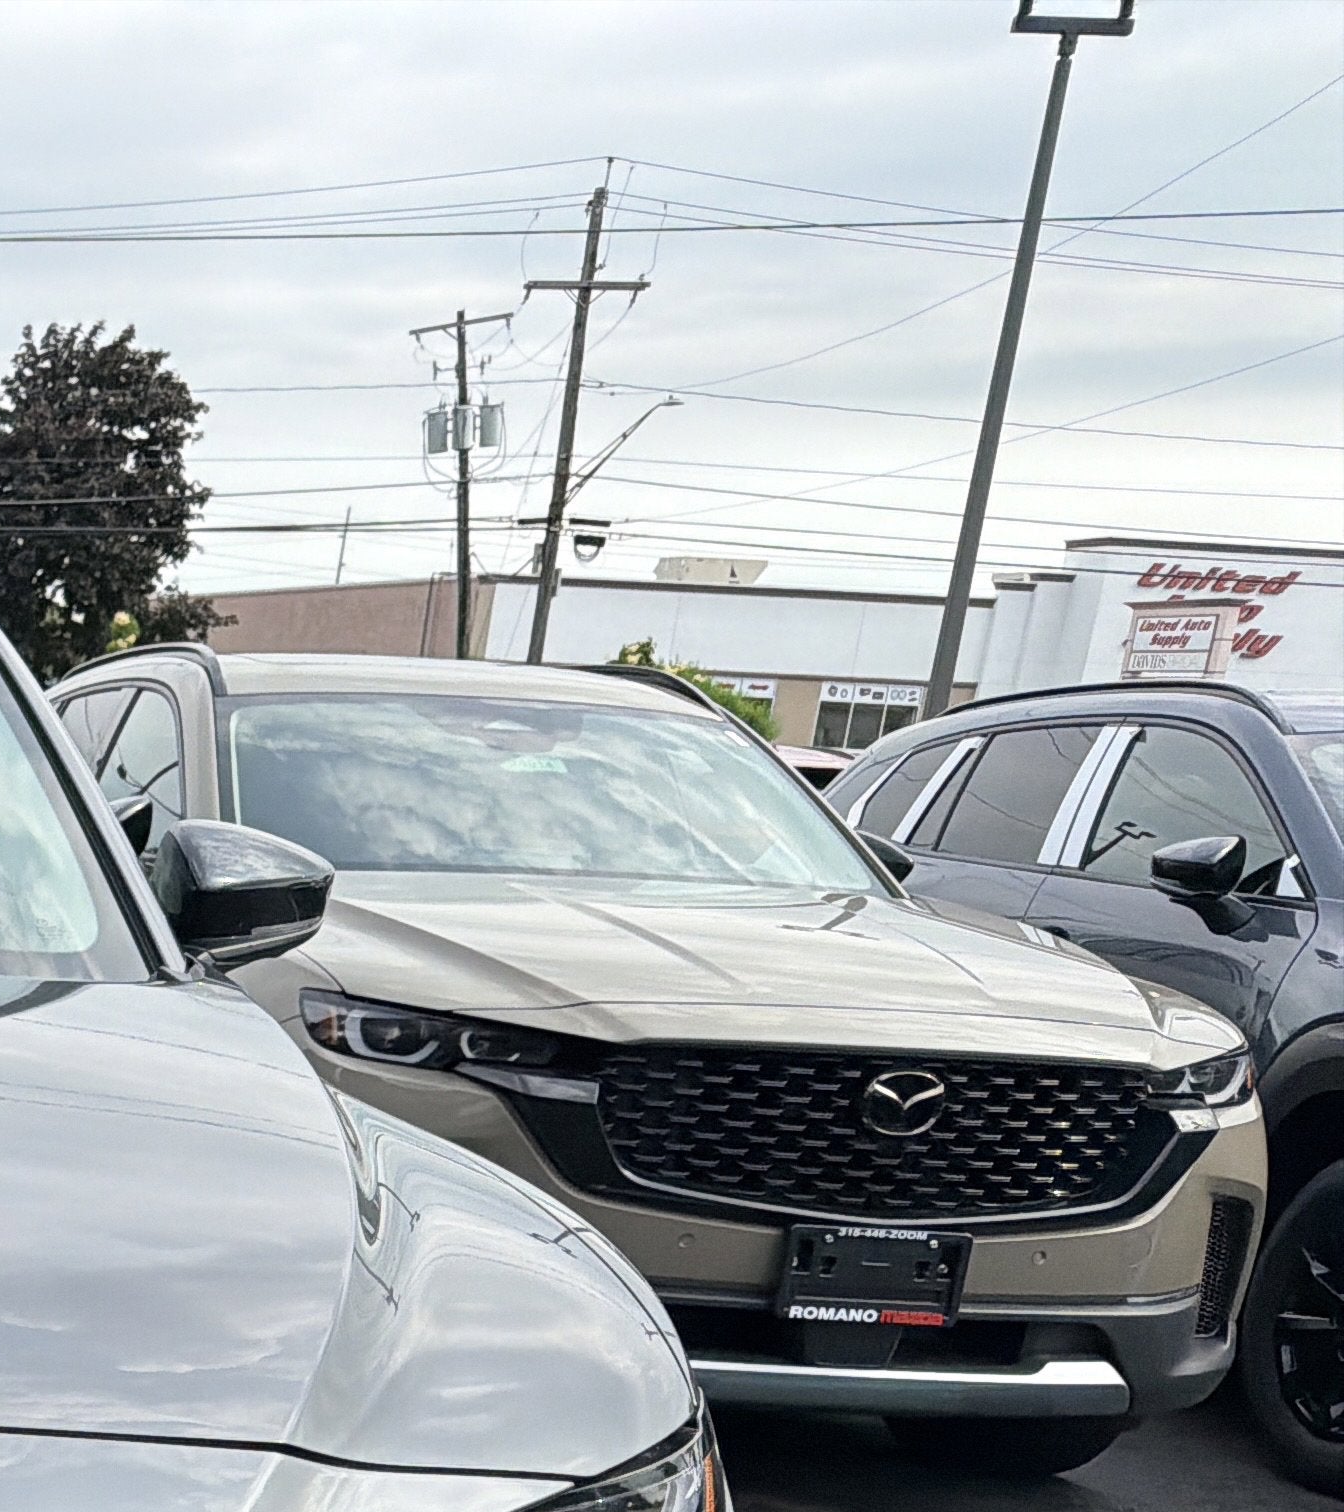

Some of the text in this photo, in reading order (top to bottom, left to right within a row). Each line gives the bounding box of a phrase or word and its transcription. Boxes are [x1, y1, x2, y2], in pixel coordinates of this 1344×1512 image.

[1137, 562, 1303, 595] United
[1139, 618, 1212, 632] United Auto
[1149, 633, 1192, 649] Supply
[788, 1305, 878, 1323] ROMANO
